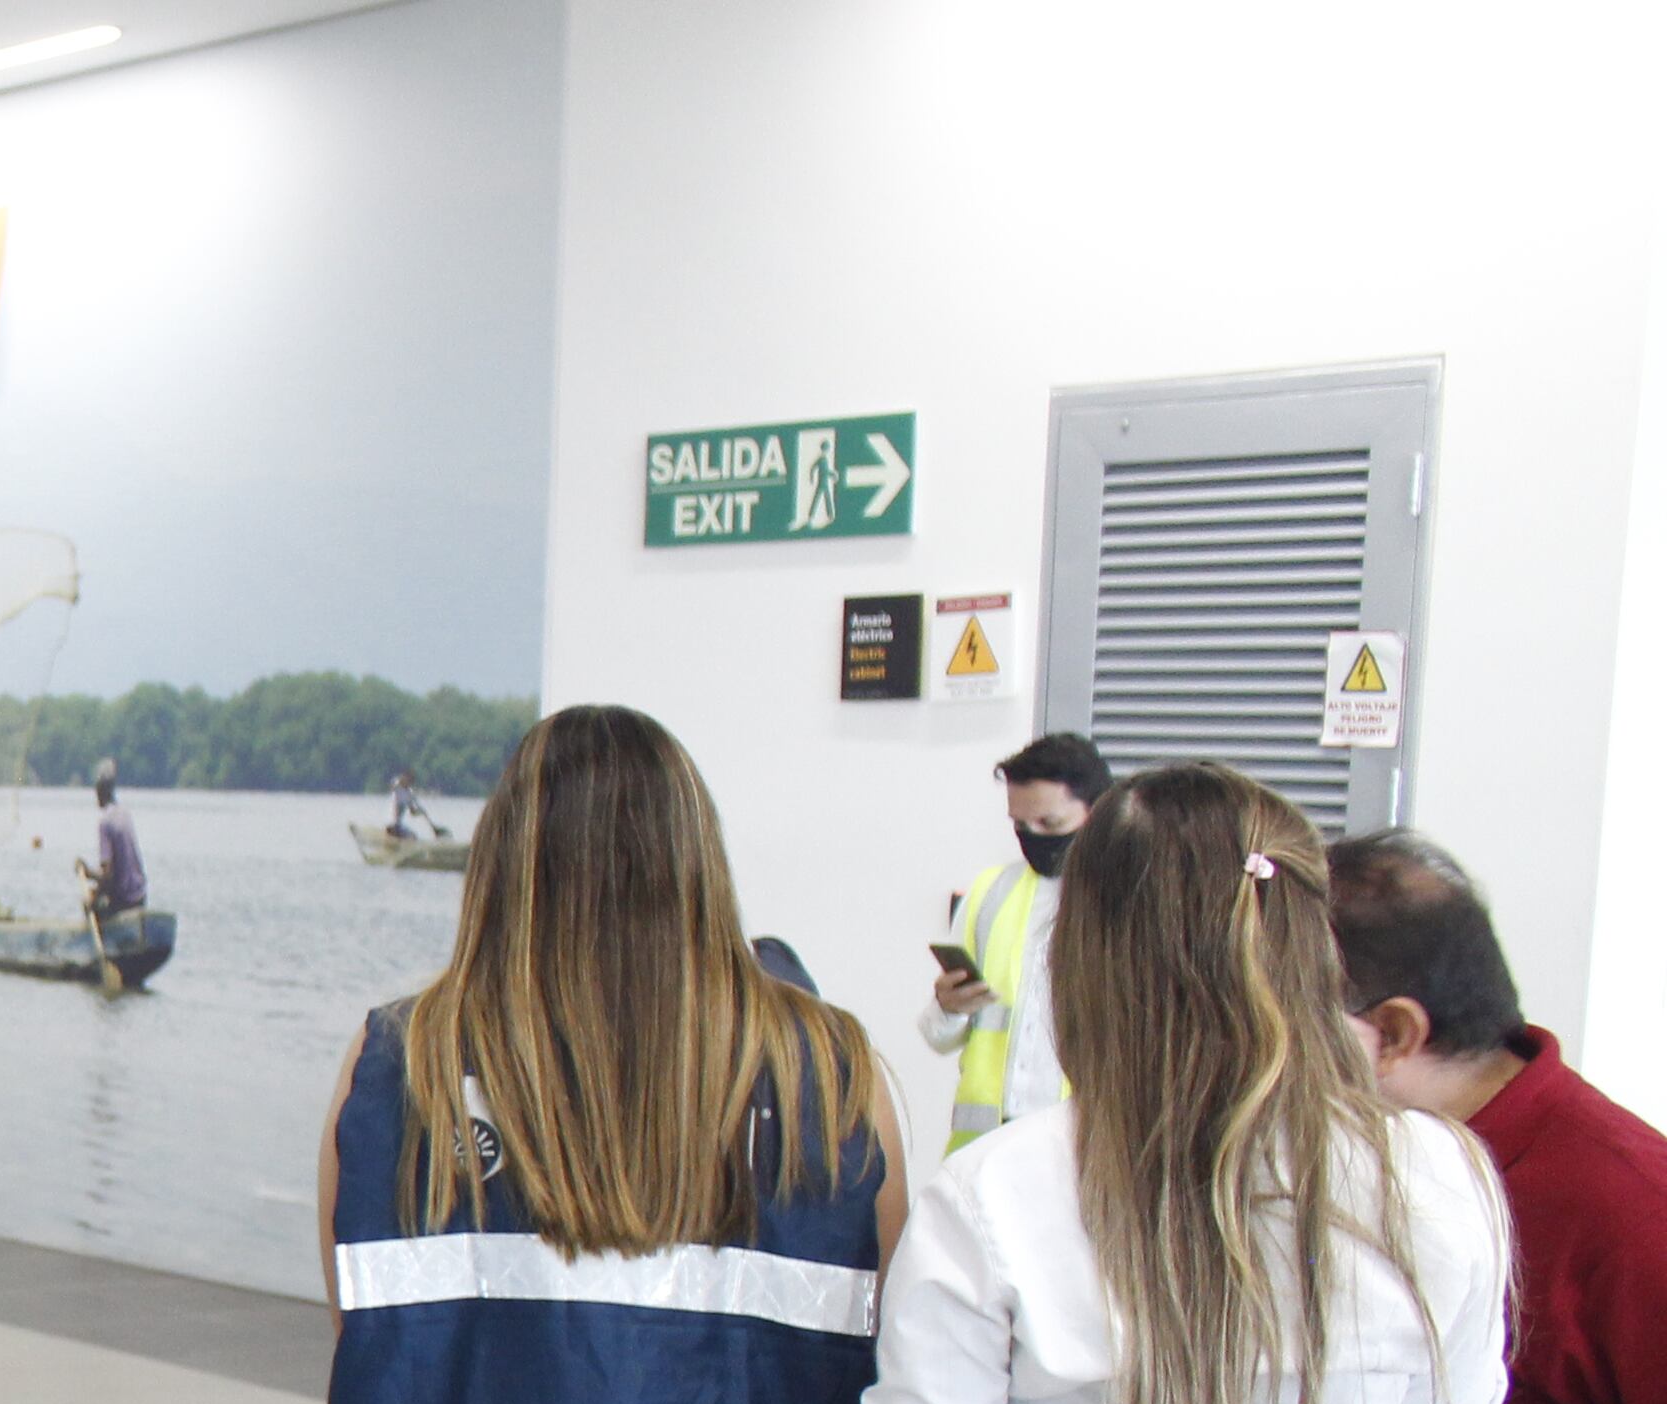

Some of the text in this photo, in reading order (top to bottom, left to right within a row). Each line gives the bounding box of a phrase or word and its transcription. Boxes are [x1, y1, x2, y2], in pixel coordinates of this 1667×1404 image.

[650, 435, 787, 484] SALIDA
[674, 490, 760, 538] EXIT
[1328, 701, 1398, 711] ALTO VOLTAJE
